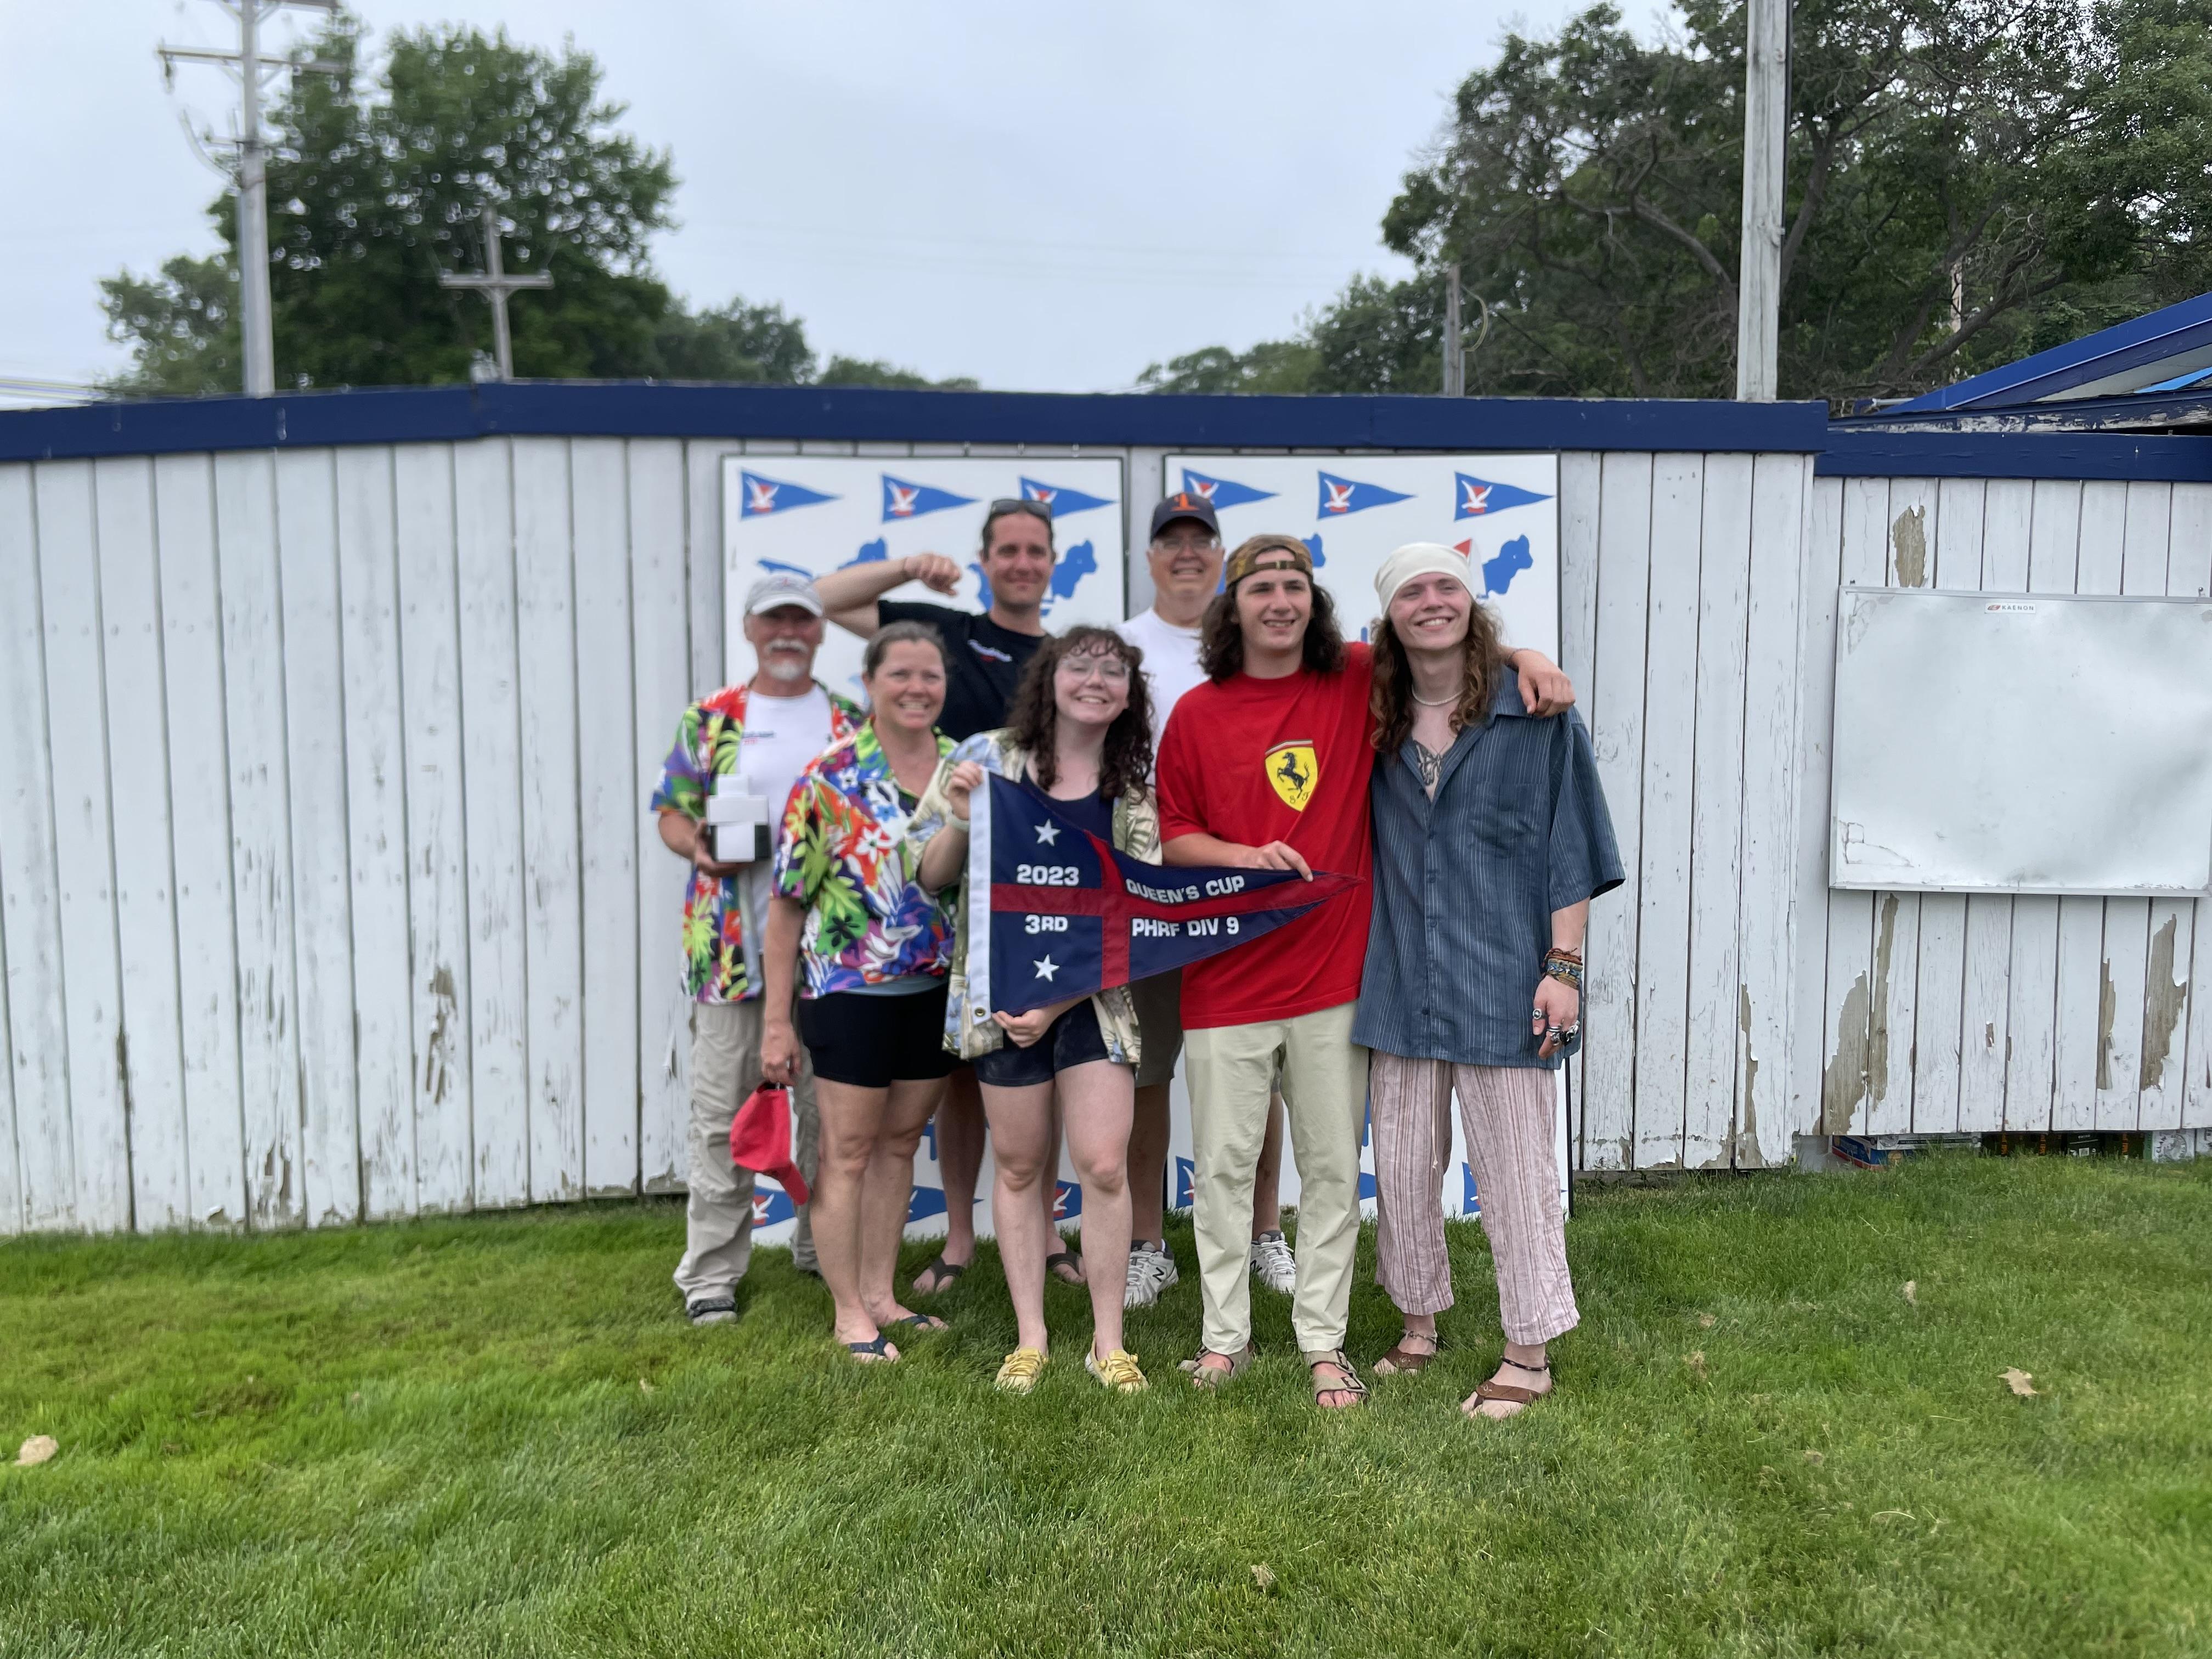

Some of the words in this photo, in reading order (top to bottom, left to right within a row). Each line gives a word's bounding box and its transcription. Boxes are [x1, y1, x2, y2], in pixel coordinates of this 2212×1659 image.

[1017, 864, 1079, 887] 2023
[1125, 878, 1200, 904] QUEEN'S
[1205, 875, 1245, 896] CUP
[1025, 914, 1068, 934] 3RD
[1132, 918, 1180, 937] PHRF
[1187, 917, 1219, 936] DIV
[1226, 916, 1239, 935] 9
